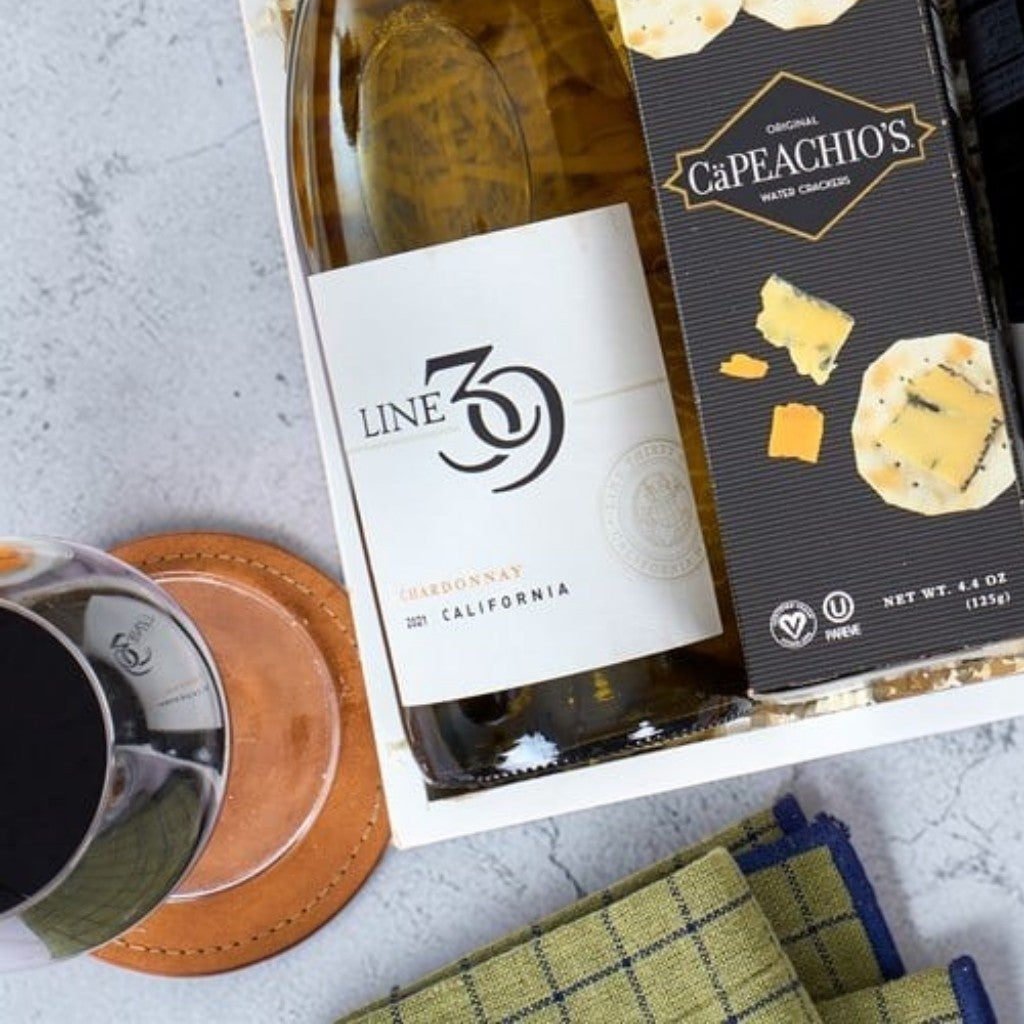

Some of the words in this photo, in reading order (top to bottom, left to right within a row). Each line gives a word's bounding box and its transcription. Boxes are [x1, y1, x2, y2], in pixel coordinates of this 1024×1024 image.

[765, 115, 820, 135] ORIGINAL
[760, 188, 795, 203] WATER
[798, 175, 851, 194] CRACKERS
[358, 390, 447, 439] LINE
[425, 344, 565, 494] 39
[399, 563, 525, 602] CHARDONNAY
[441, 581, 570, 622] CALIFORNIA
[882, 591, 916, 609] NET
[920, 583, 953, 601] WT.
[957, 577, 981, 593] 4.4
[985, 572, 1009, 587] OZ
[964, 590, 1012, 611] (125g)
